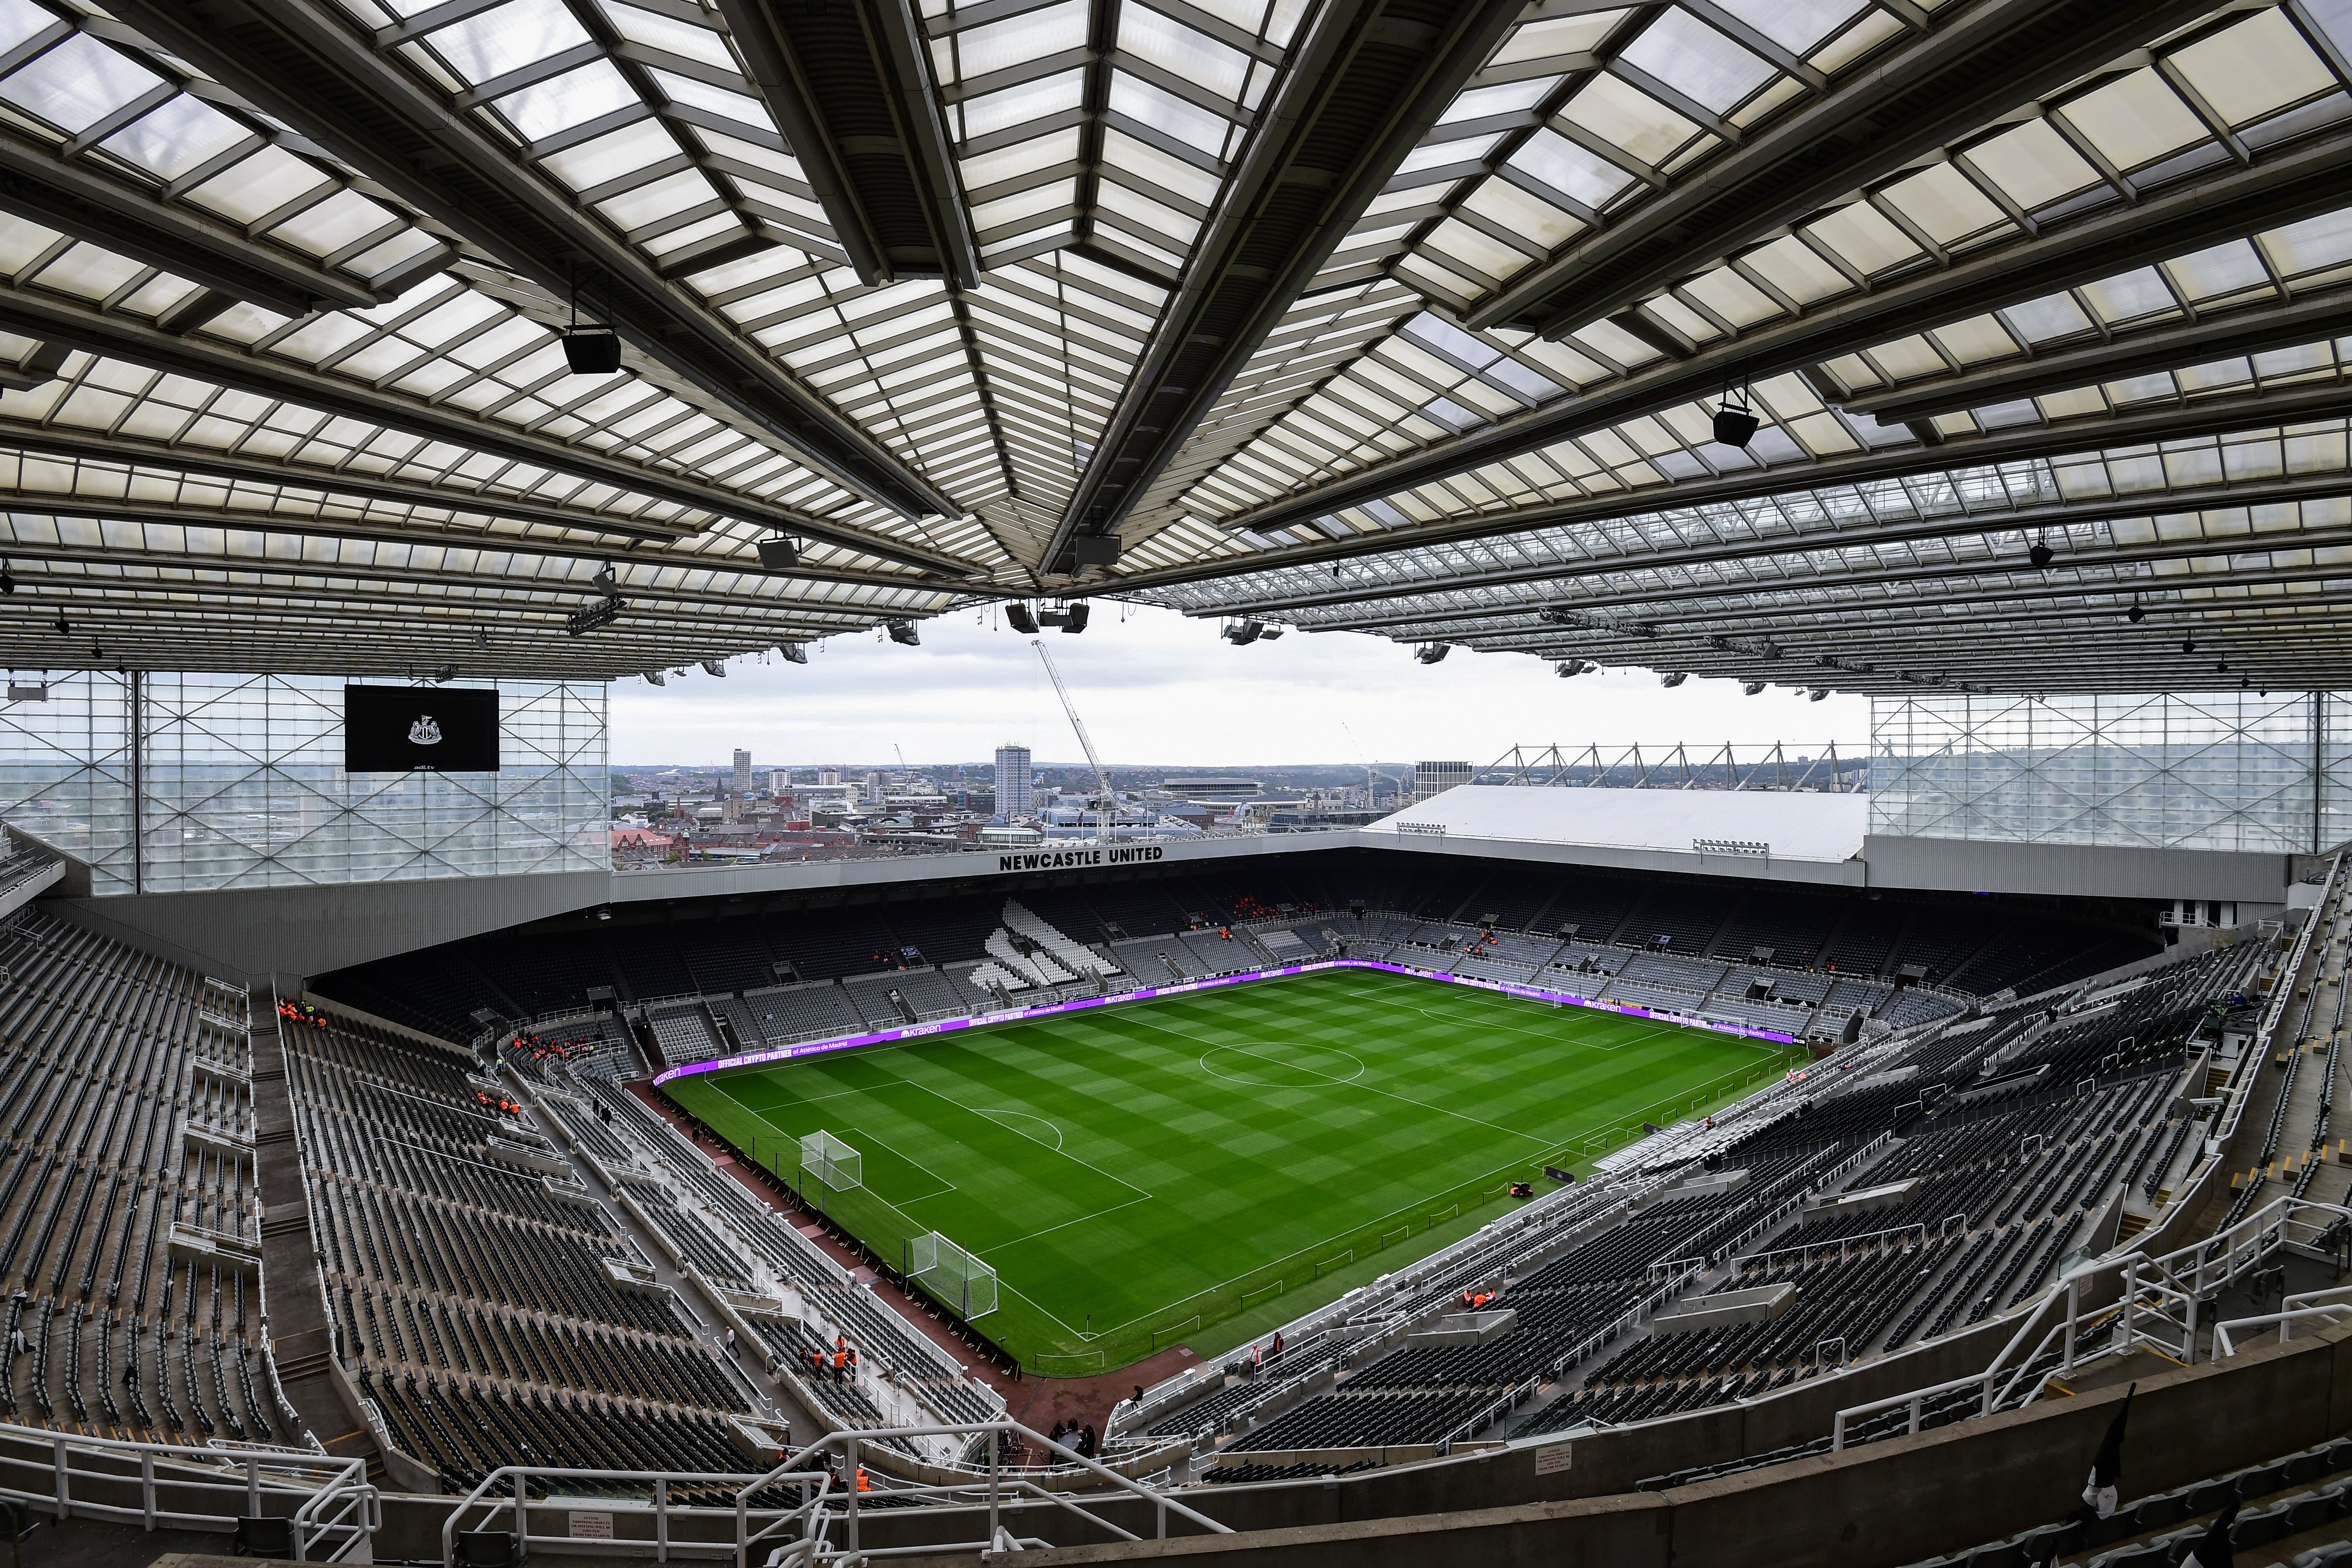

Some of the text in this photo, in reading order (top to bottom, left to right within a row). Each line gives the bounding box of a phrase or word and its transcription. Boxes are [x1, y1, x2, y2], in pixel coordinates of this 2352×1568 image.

[1000, 847, 1163, 871] NEWCASTLE UNITED
[969, 1017, 987, 1026] OFFICIAL
[988, 1015, 1004, 1024] CRYPTO
[1005, 1011, 1023, 1022] PARTNER
[1649, 1012, 1669, 1022] OFFICIAL
[1670, 1015, 1689, 1025] CRYPTO
[718, 1057, 743, 1069] OFFICIAL
[744, 1054, 766, 1065] CRYPTO
[767, 1049, 792, 1060] PARTNER
